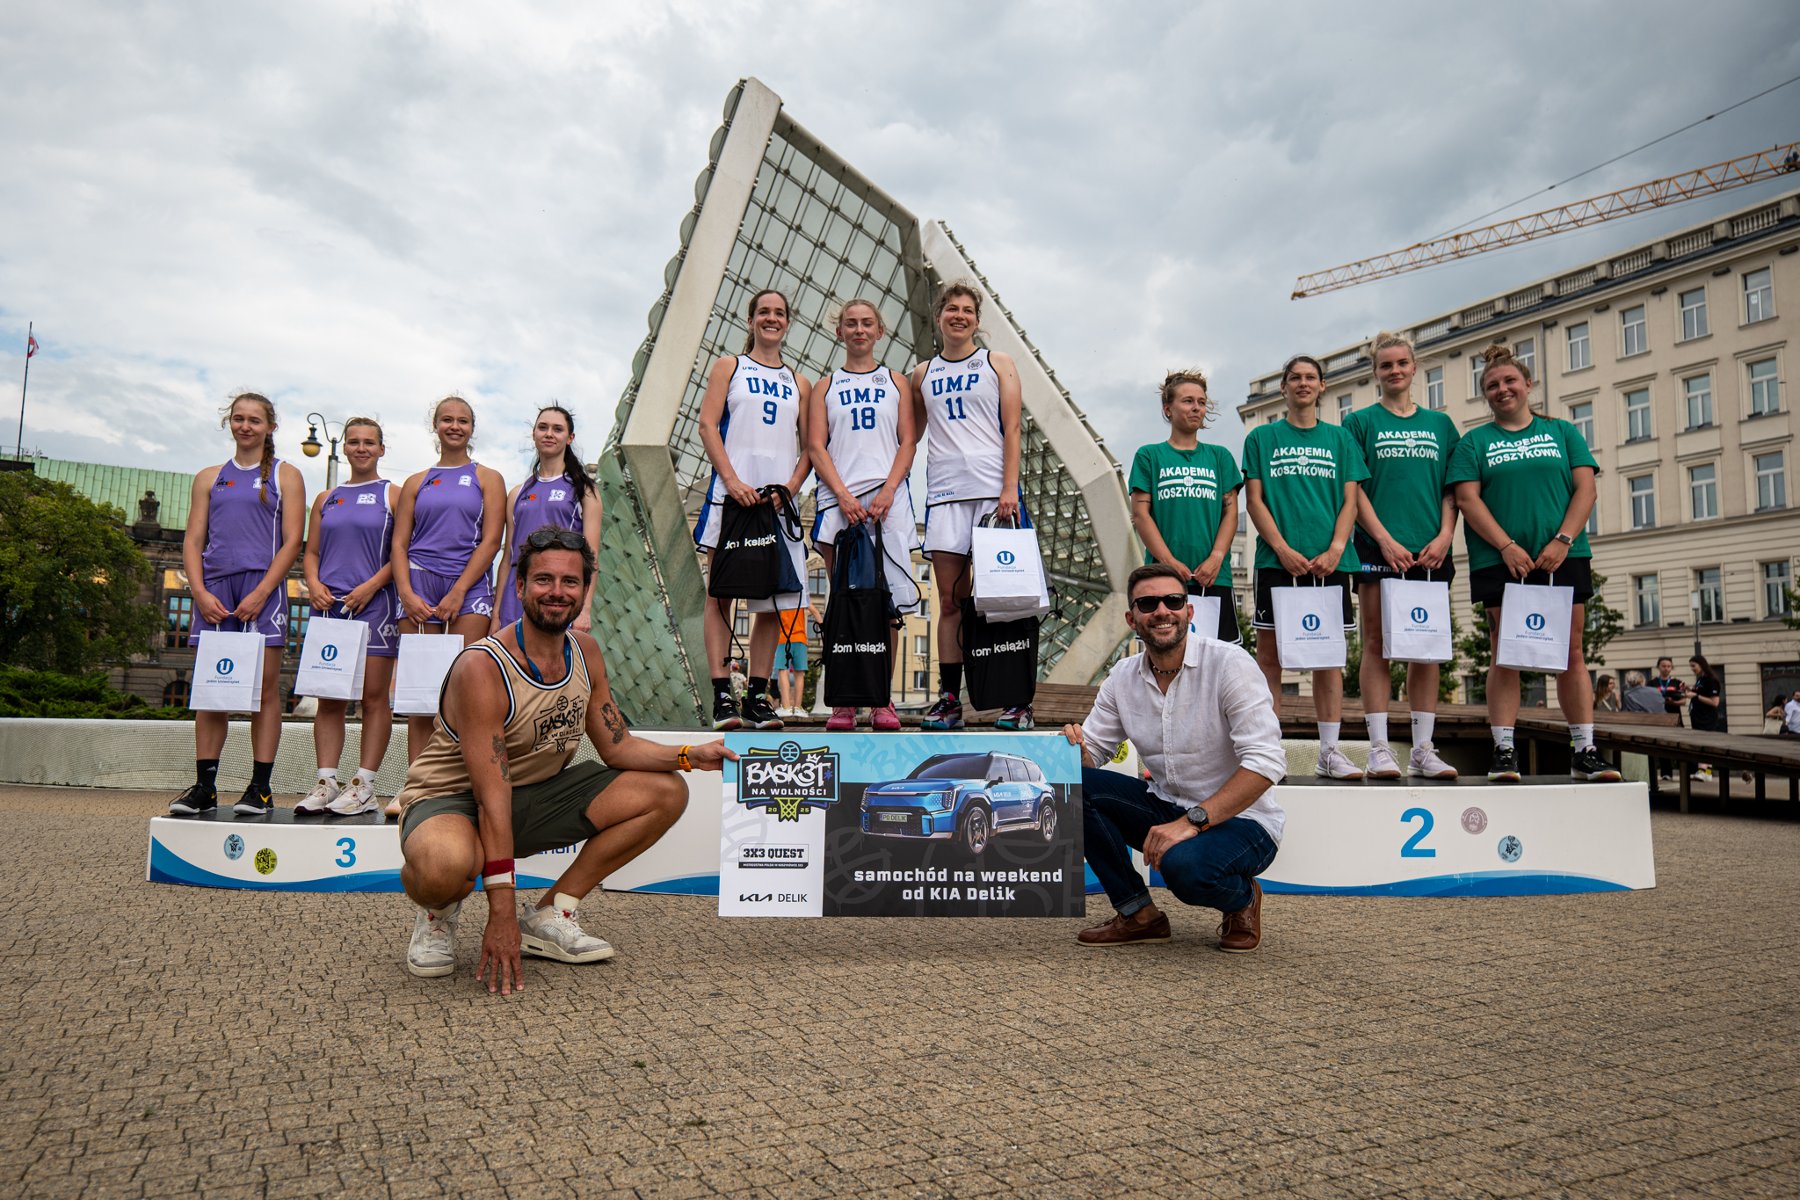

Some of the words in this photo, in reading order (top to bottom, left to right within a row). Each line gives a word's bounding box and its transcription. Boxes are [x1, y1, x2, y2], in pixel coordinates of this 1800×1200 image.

[746, 377, 792, 400] UMP
[931, 373, 980, 396] UMP
[838, 387, 885, 406] UMP
[762, 400, 777, 425] 9
[945, 396, 967, 420] 11
[850, 407, 876, 430] 18
[1377, 430, 1437, 442] AKADEMIA
[1488, 433, 1554, 451] AKADEMIA
[1272, 447, 1333, 459] AKADEMIA
[1487, 446, 1562, 468] KOSZYKÓWKI
[1159, 466, 1216, 480] AKADEMIA
[1270, 464, 1336, 479] KOSZYKÓWKI
[751, 788, 766, 796] NA
[770, 786, 827, 796] WOLNOŚCI
[1400, 807, 1436, 858] 2
[335, 837, 357, 868] 3
[743, 848, 766, 859] 3X3
[768, 848, 804, 860] QUEST
[854, 867, 948, 883] samochód
[954, 870, 975, 883] na
[980, 868, 1063, 883] weekend
[778, 893, 808, 902] DELIK
[902, 887, 924, 901] od
[930, 887, 961, 901] KIA
[967, 886, 1016, 901] Delik
